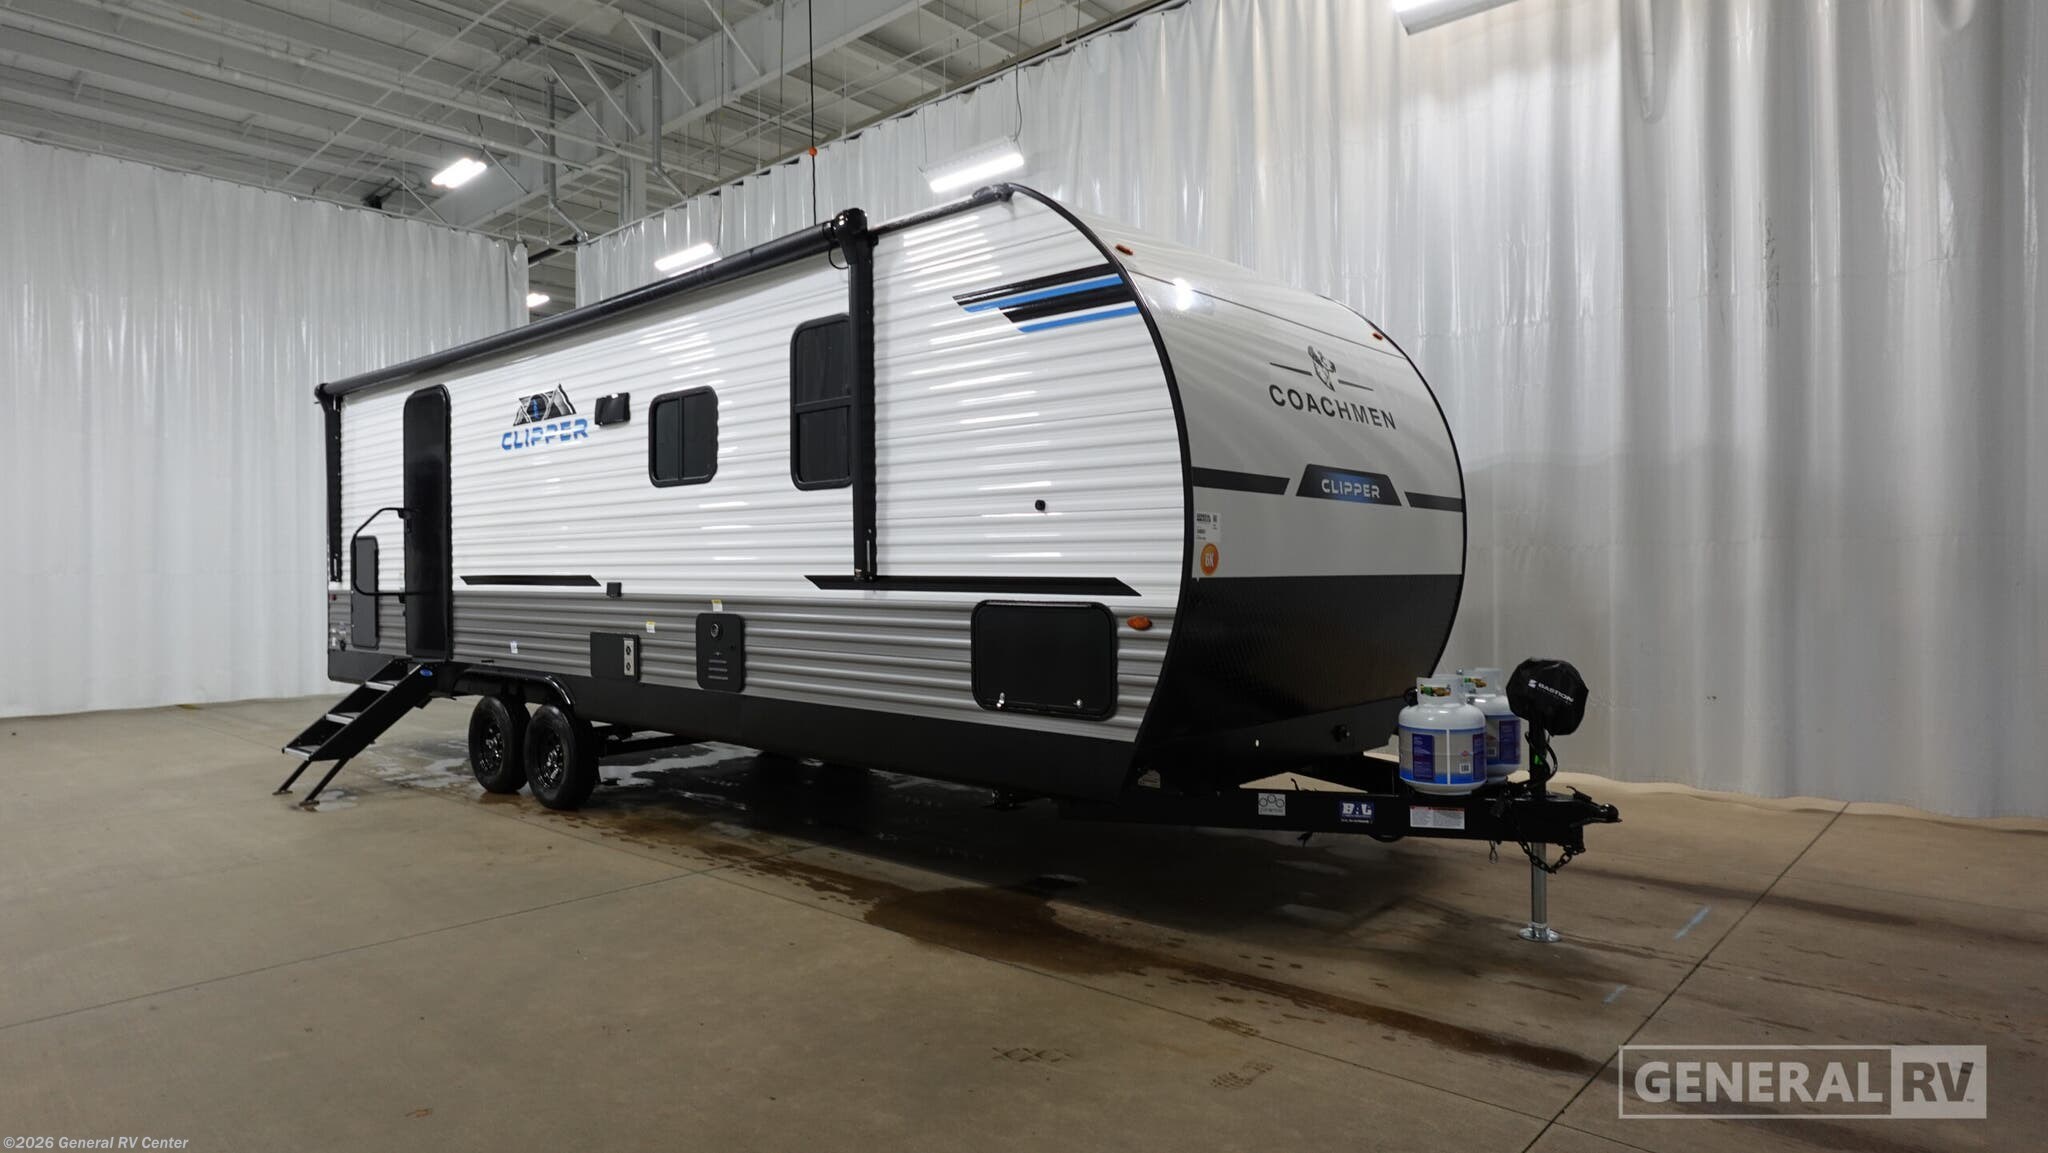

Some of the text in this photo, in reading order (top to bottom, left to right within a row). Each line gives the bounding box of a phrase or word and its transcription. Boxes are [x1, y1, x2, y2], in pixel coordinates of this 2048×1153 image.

[1268, 384, 1398, 430] COACHMEN
[501, 418, 589, 451] CLIPPER
[1321, 478, 1381, 499] CLIPPER
[1538, 682, 1574, 703] BASTION
